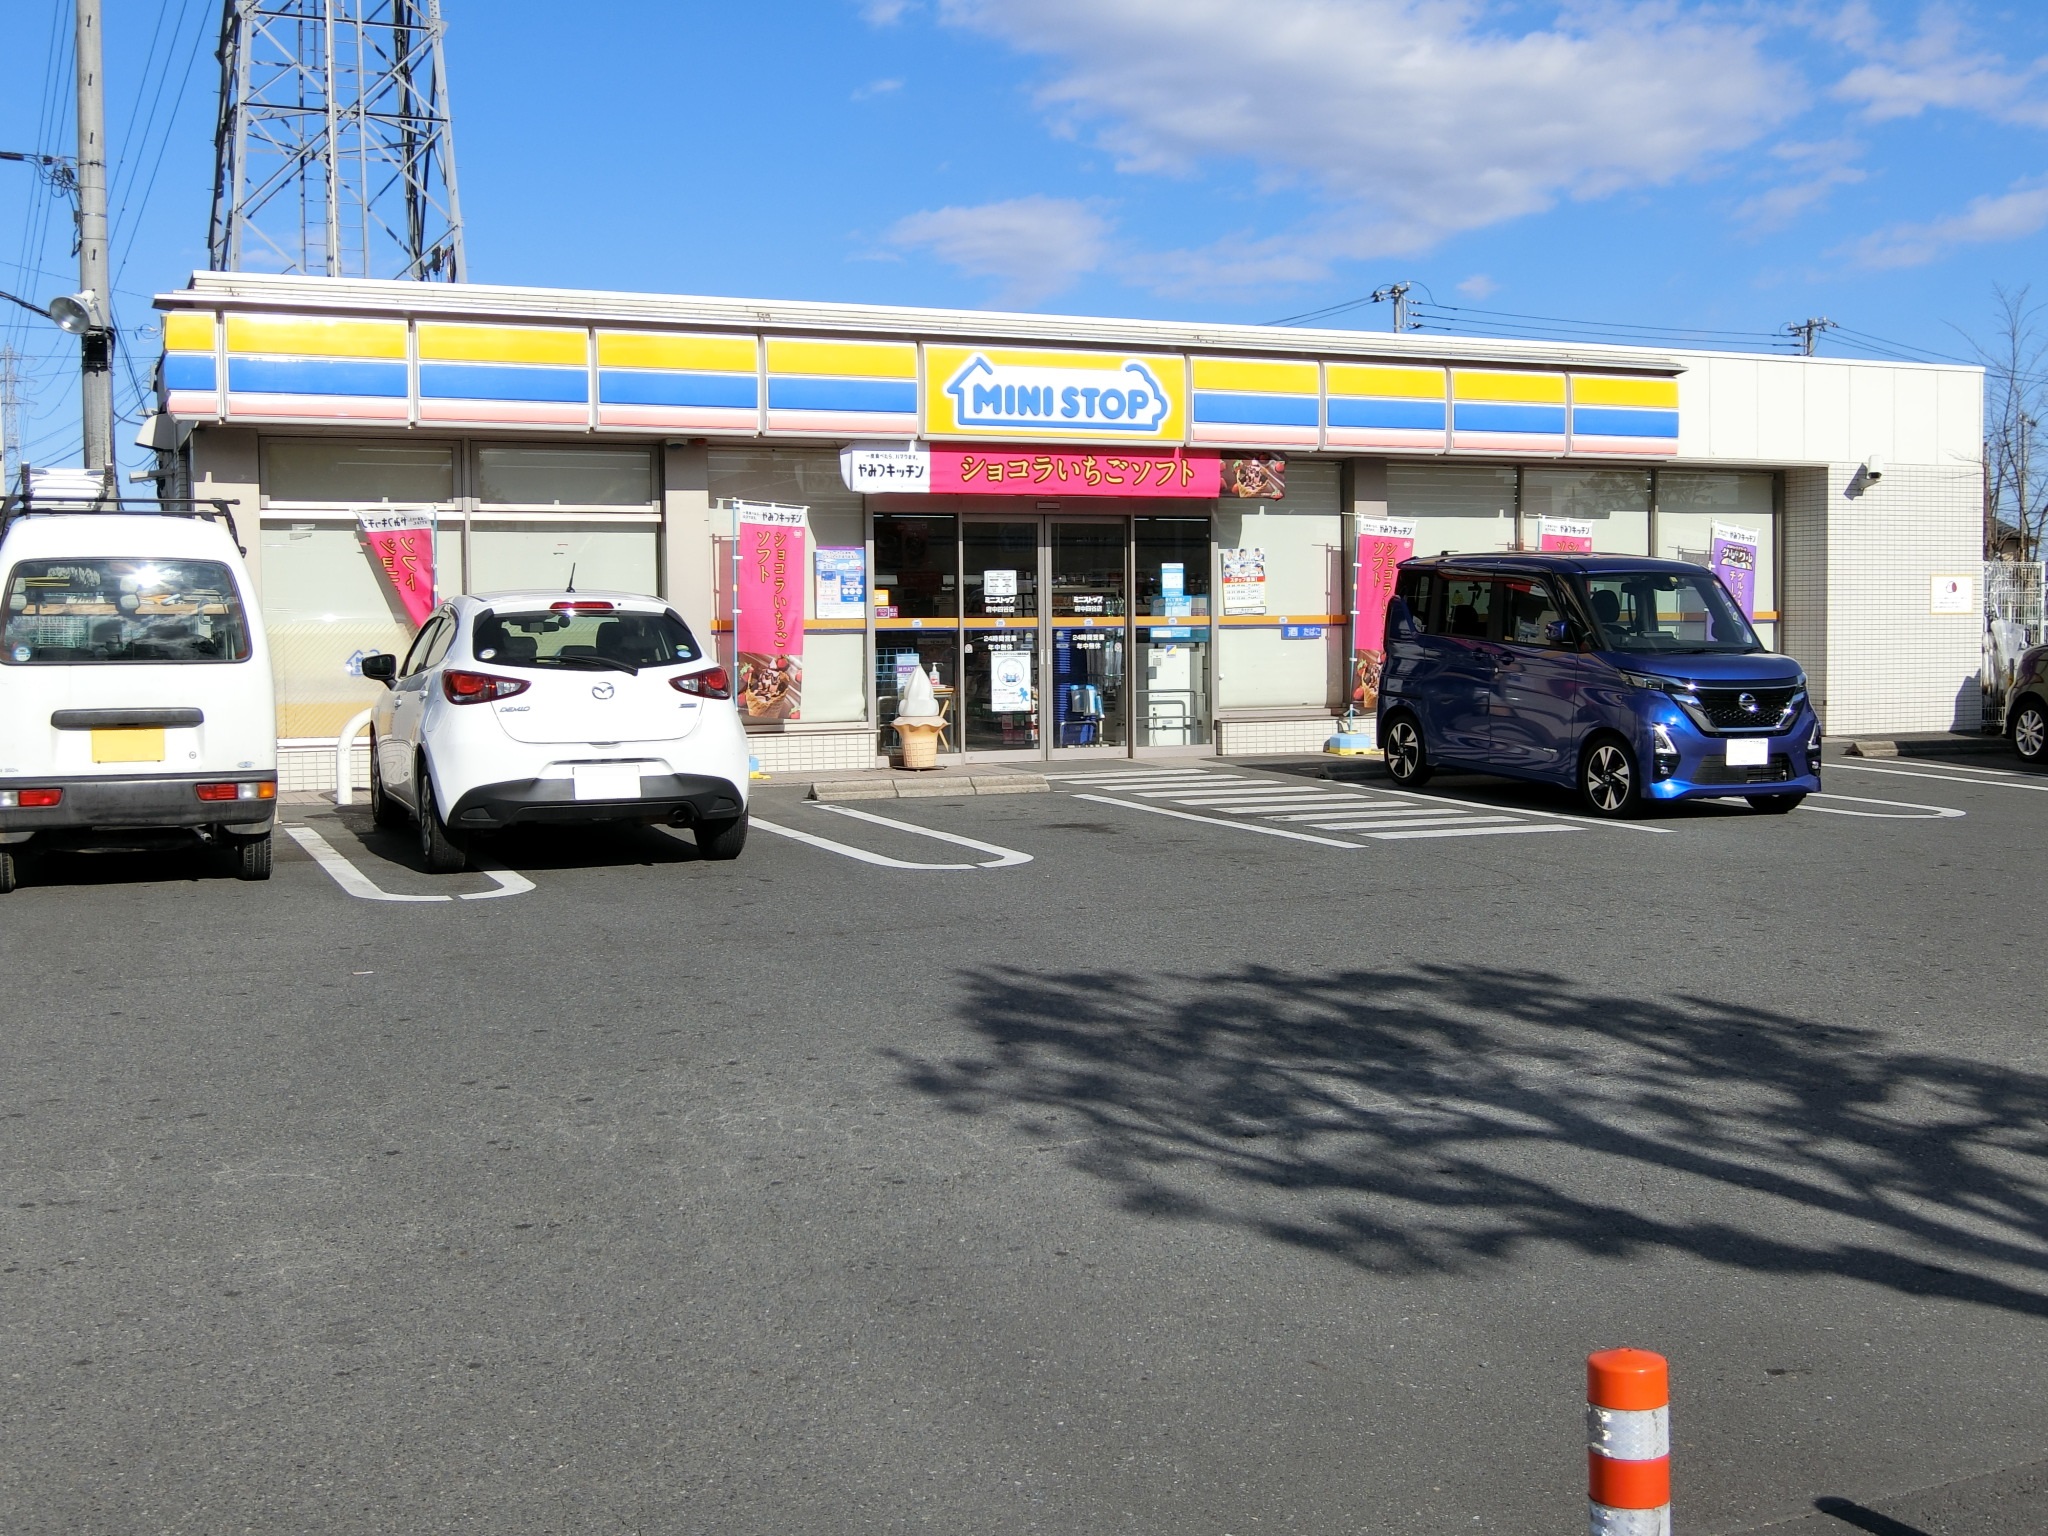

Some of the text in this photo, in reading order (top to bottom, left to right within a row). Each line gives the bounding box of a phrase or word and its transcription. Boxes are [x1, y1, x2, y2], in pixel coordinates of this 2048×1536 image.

[973, 383, 1150, 420] MINI STOP
[858, 463, 925, 479] やみつキッチン
[961, 455, 1194, 487] ショコラいちごソフト
[762, 511, 803, 523] やみつキッチン
[1379, 524, 1413, 536] やみつキッチン
[1560, 524, 1590, 535] やみつキッチン
[756, 531, 771, 583] ソフト
[1372, 542, 1385, 588] ソフト
[774, 531, 788, 648] ショコラいちご
[984, 596, 1016, 604] ミニストップ
[1073, 595, 1104, 603] ミニストップ
[1072, 633, 1105, 641] 24時間営業
[1287, 626, 1321, 637] 酒 たばこ
[984, 635, 1018, 643] 24時間営業
[987, 643, 1014, 651] 年中無休
[1076, 642, 1102, 650] 年中無休
